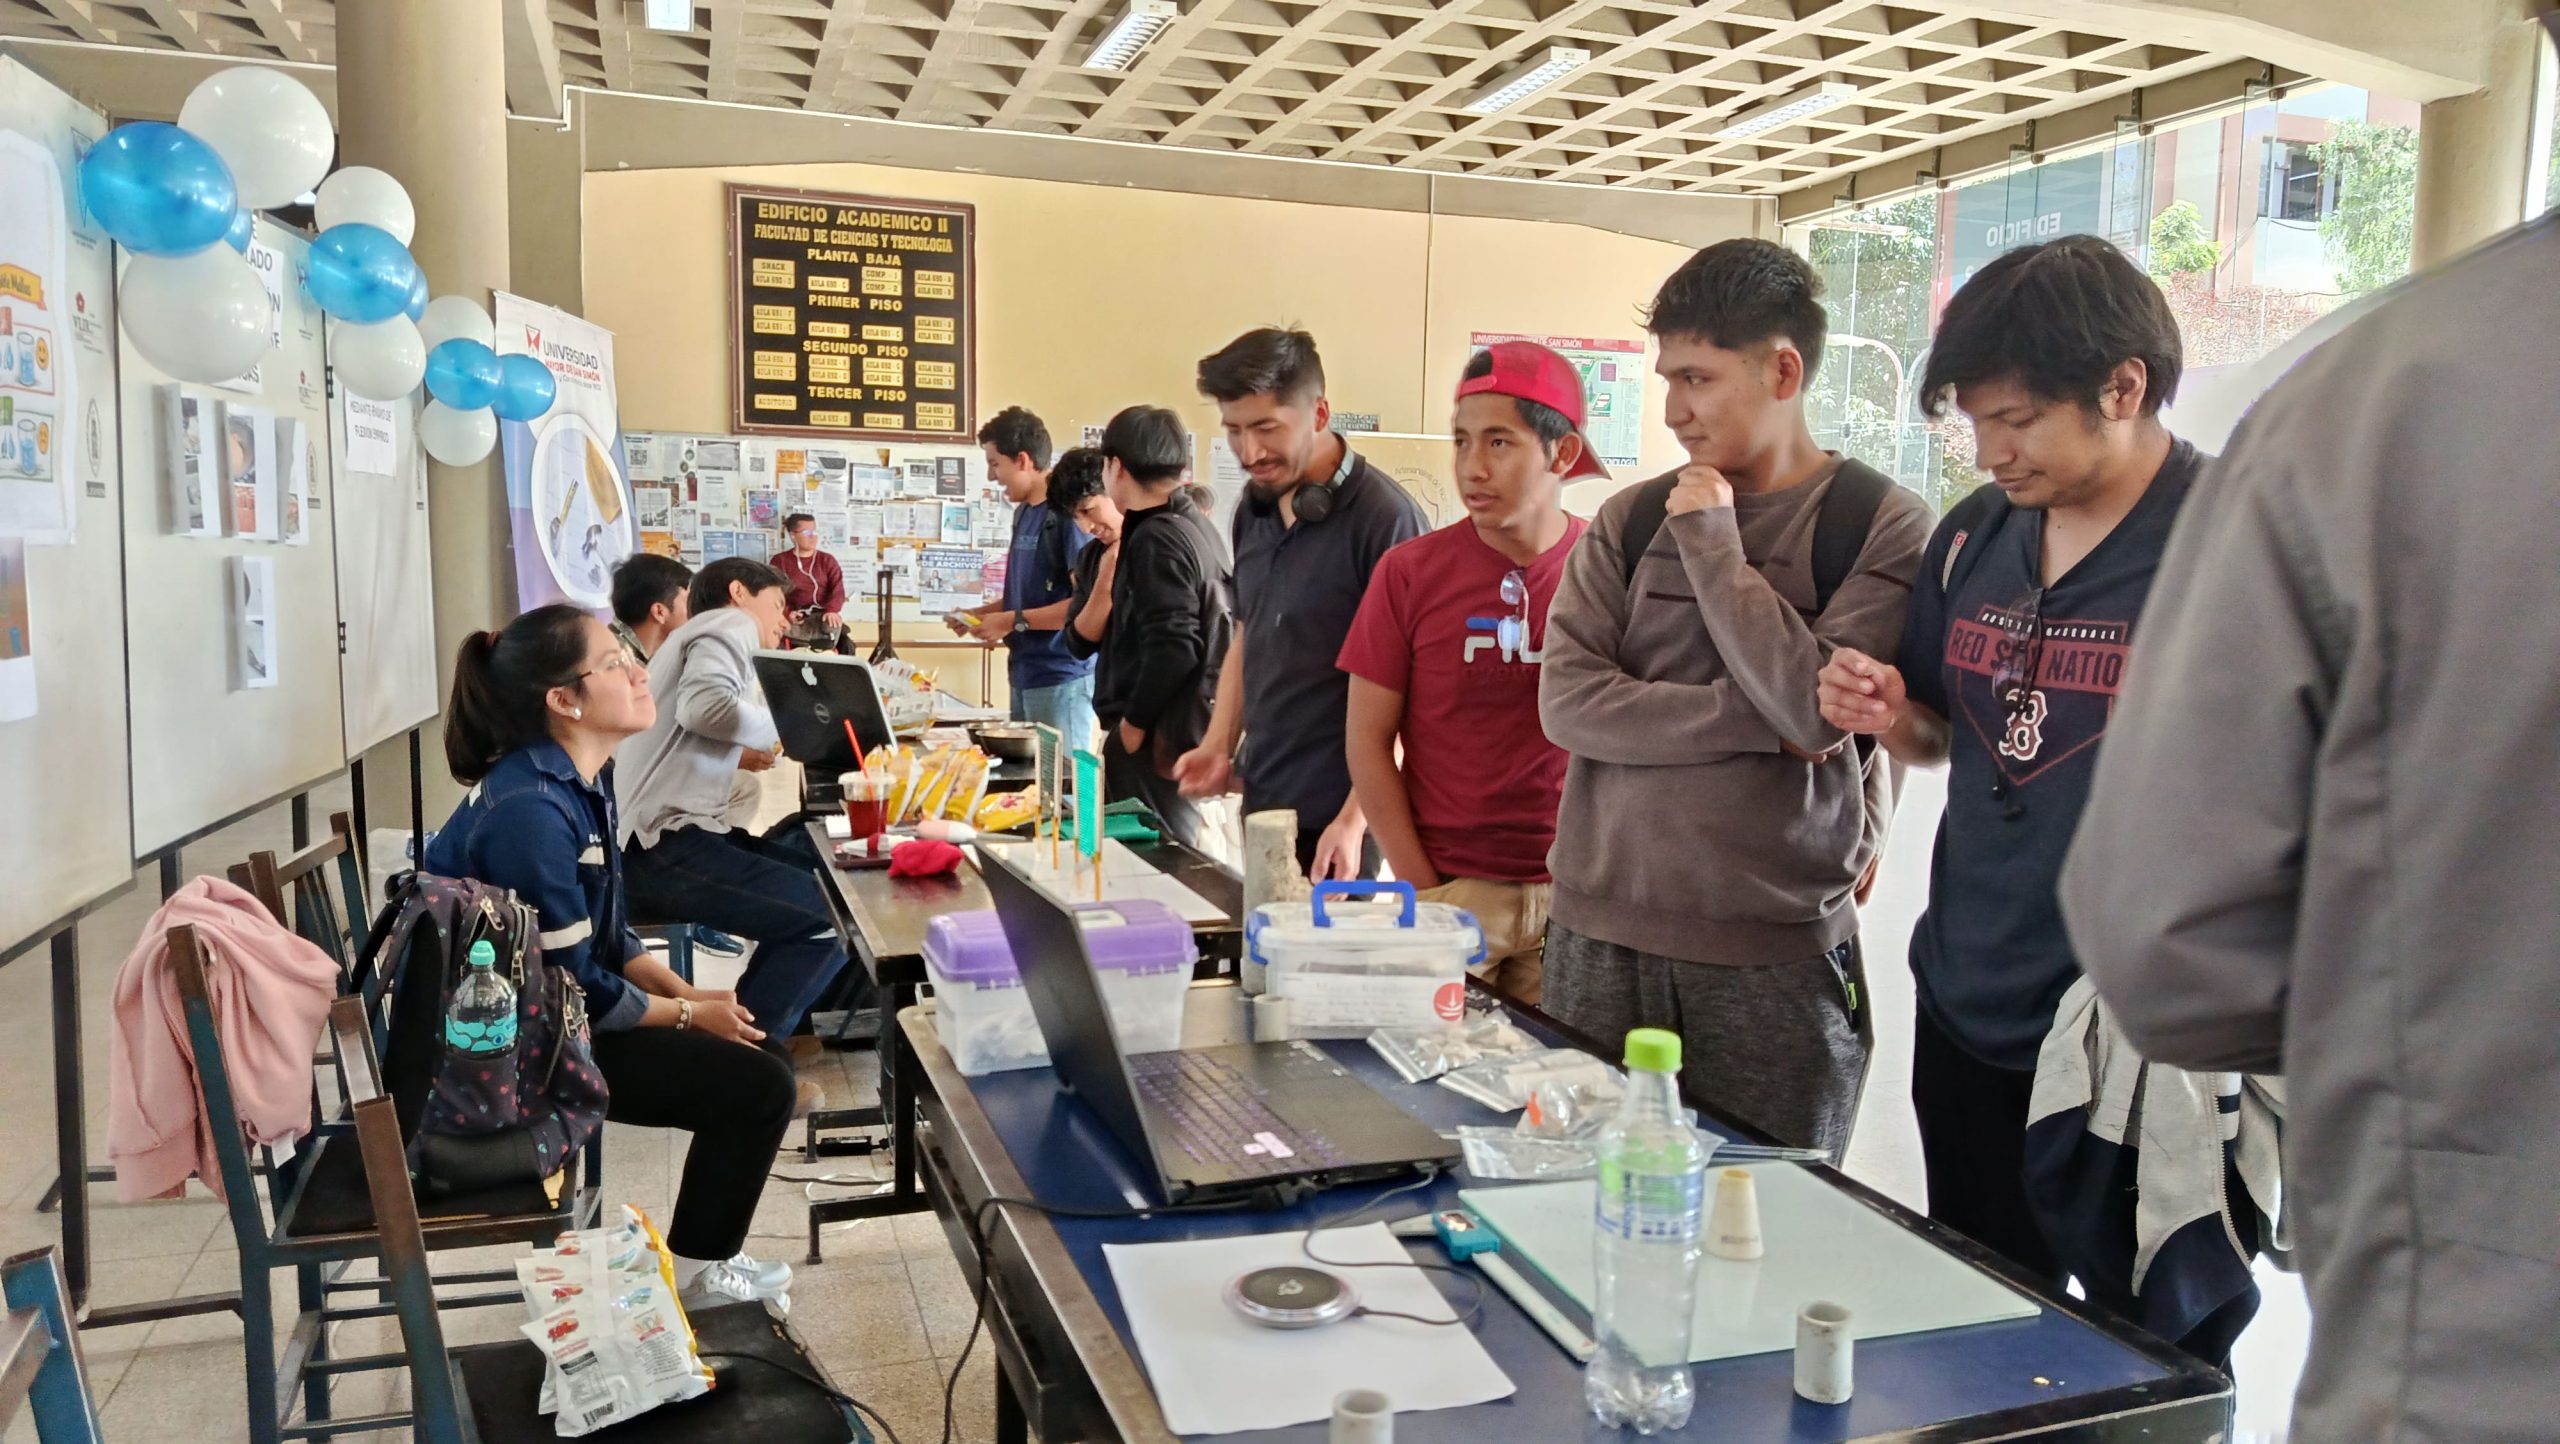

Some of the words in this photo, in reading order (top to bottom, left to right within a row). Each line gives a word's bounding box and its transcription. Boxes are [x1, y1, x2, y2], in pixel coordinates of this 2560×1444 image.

[758, 202, 828, 223] EDIFICIO
[836, 209, 932, 232] ACADEMICO
[938, 217, 948, 233] II
[754, 223, 810, 242] FACULTAD
[813, 228, 828, 243] DE
[830, 229, 879, 248] CIENCIAS
[880, 234, 889, 248] Y
[890, 234, 953, 253] TECNOLOGIA
[807, 248, 859, 263] PLANTA
[865, 252, 902, 266] BAJA
[808, 294, 860, 309] PRIMER
[869, 297, 903, 312] PISO
[543, 339, 598, 370] UNIVERSIDAD
[802, 340, 868, 355] SEGUNDO
[877, 344, 909, 358] PISO
[807, 385, 862, 400] TERCER
[874, 389, 907, 402] PISO
[921, 560, 934, 568] DE
[936, 561, 983, 569] ARCHIVOS
[1464, 616, 1544, 664] FIL
[1952, 627, 1987, 665] RED
[2046, 649, 2123, 688] NATIO
